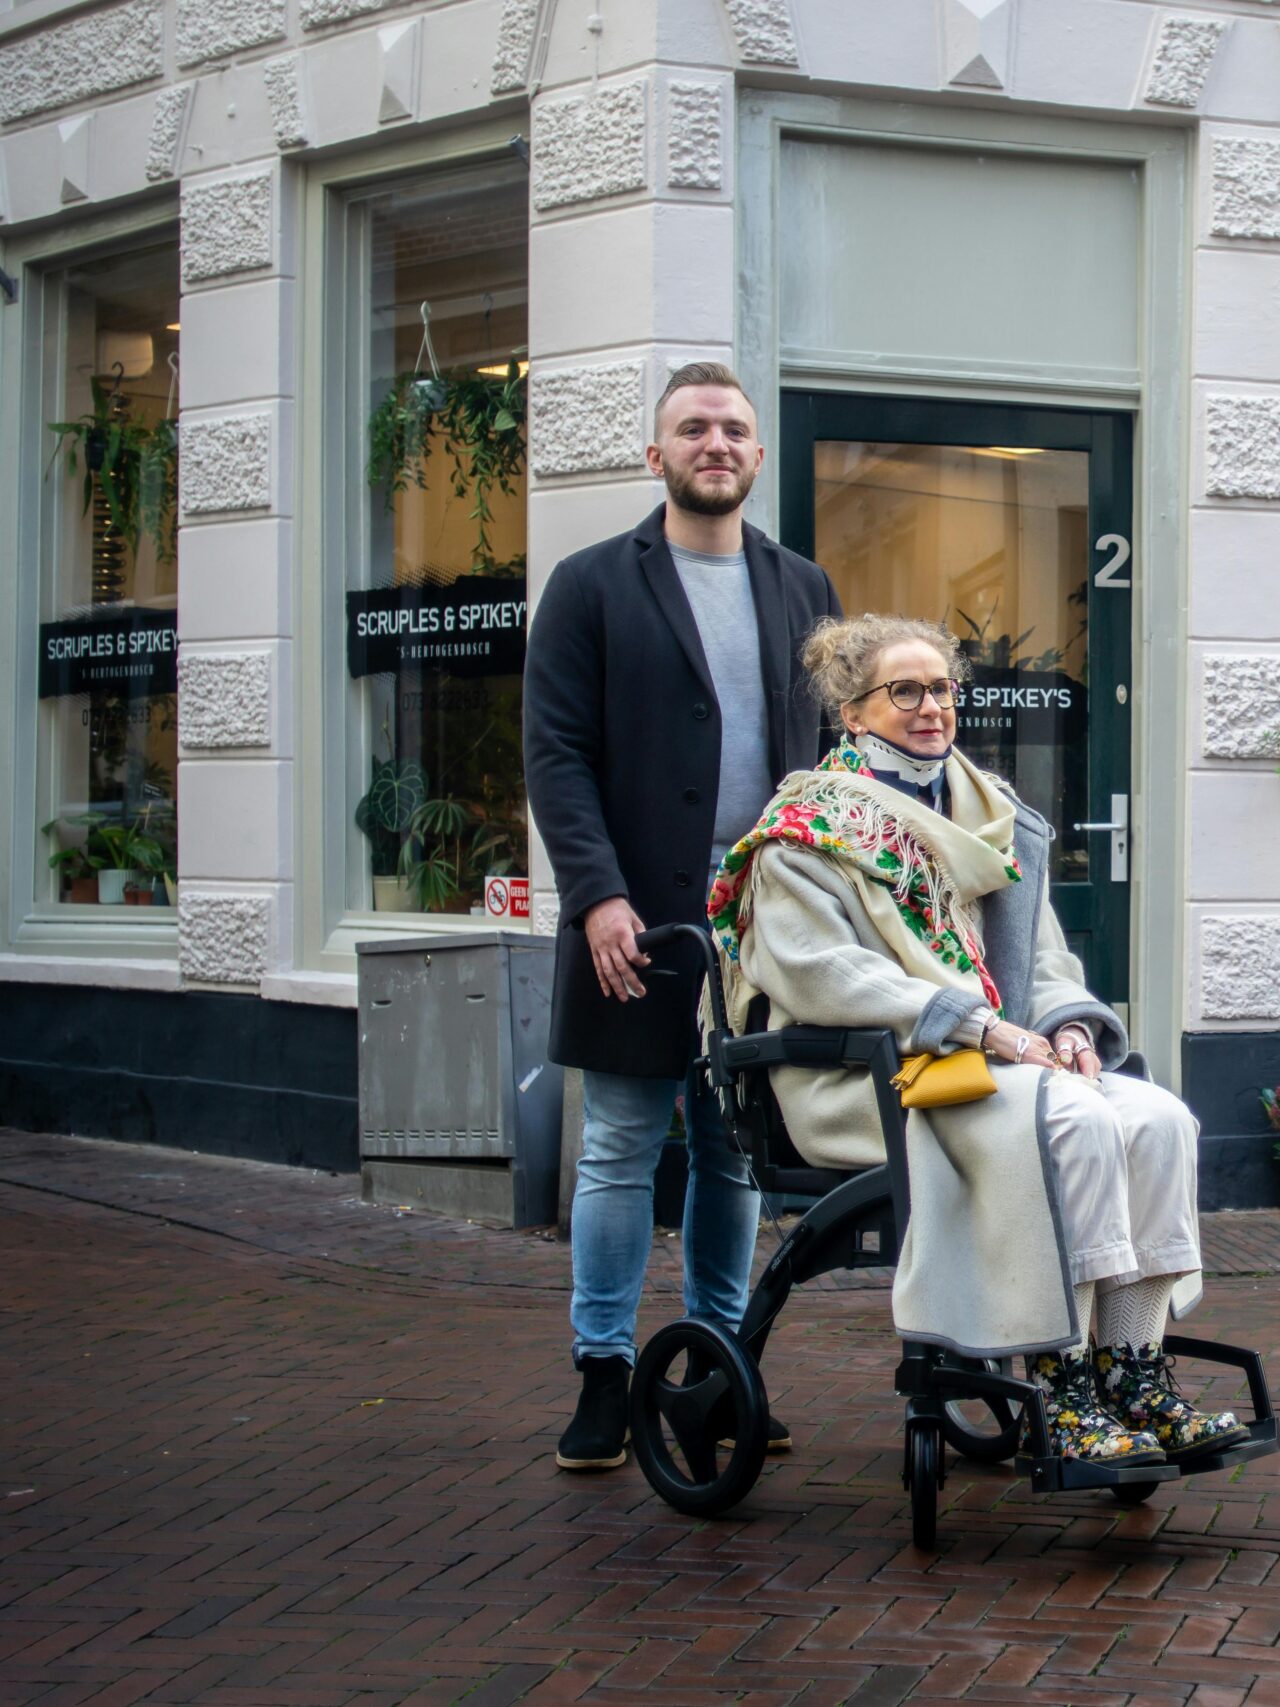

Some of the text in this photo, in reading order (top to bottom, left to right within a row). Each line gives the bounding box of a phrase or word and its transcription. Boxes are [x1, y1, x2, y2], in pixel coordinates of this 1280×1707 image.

[1094, 533, 1131, 588] 2
[357, 607, 439, 636] SCRUPLES
[444, 606, 455, 631] &
[47, 634, 113, 660] SCRUPLES
[117, 633, 126, 655] &
[972, 687, 1072, 709] SPIKEY'S
